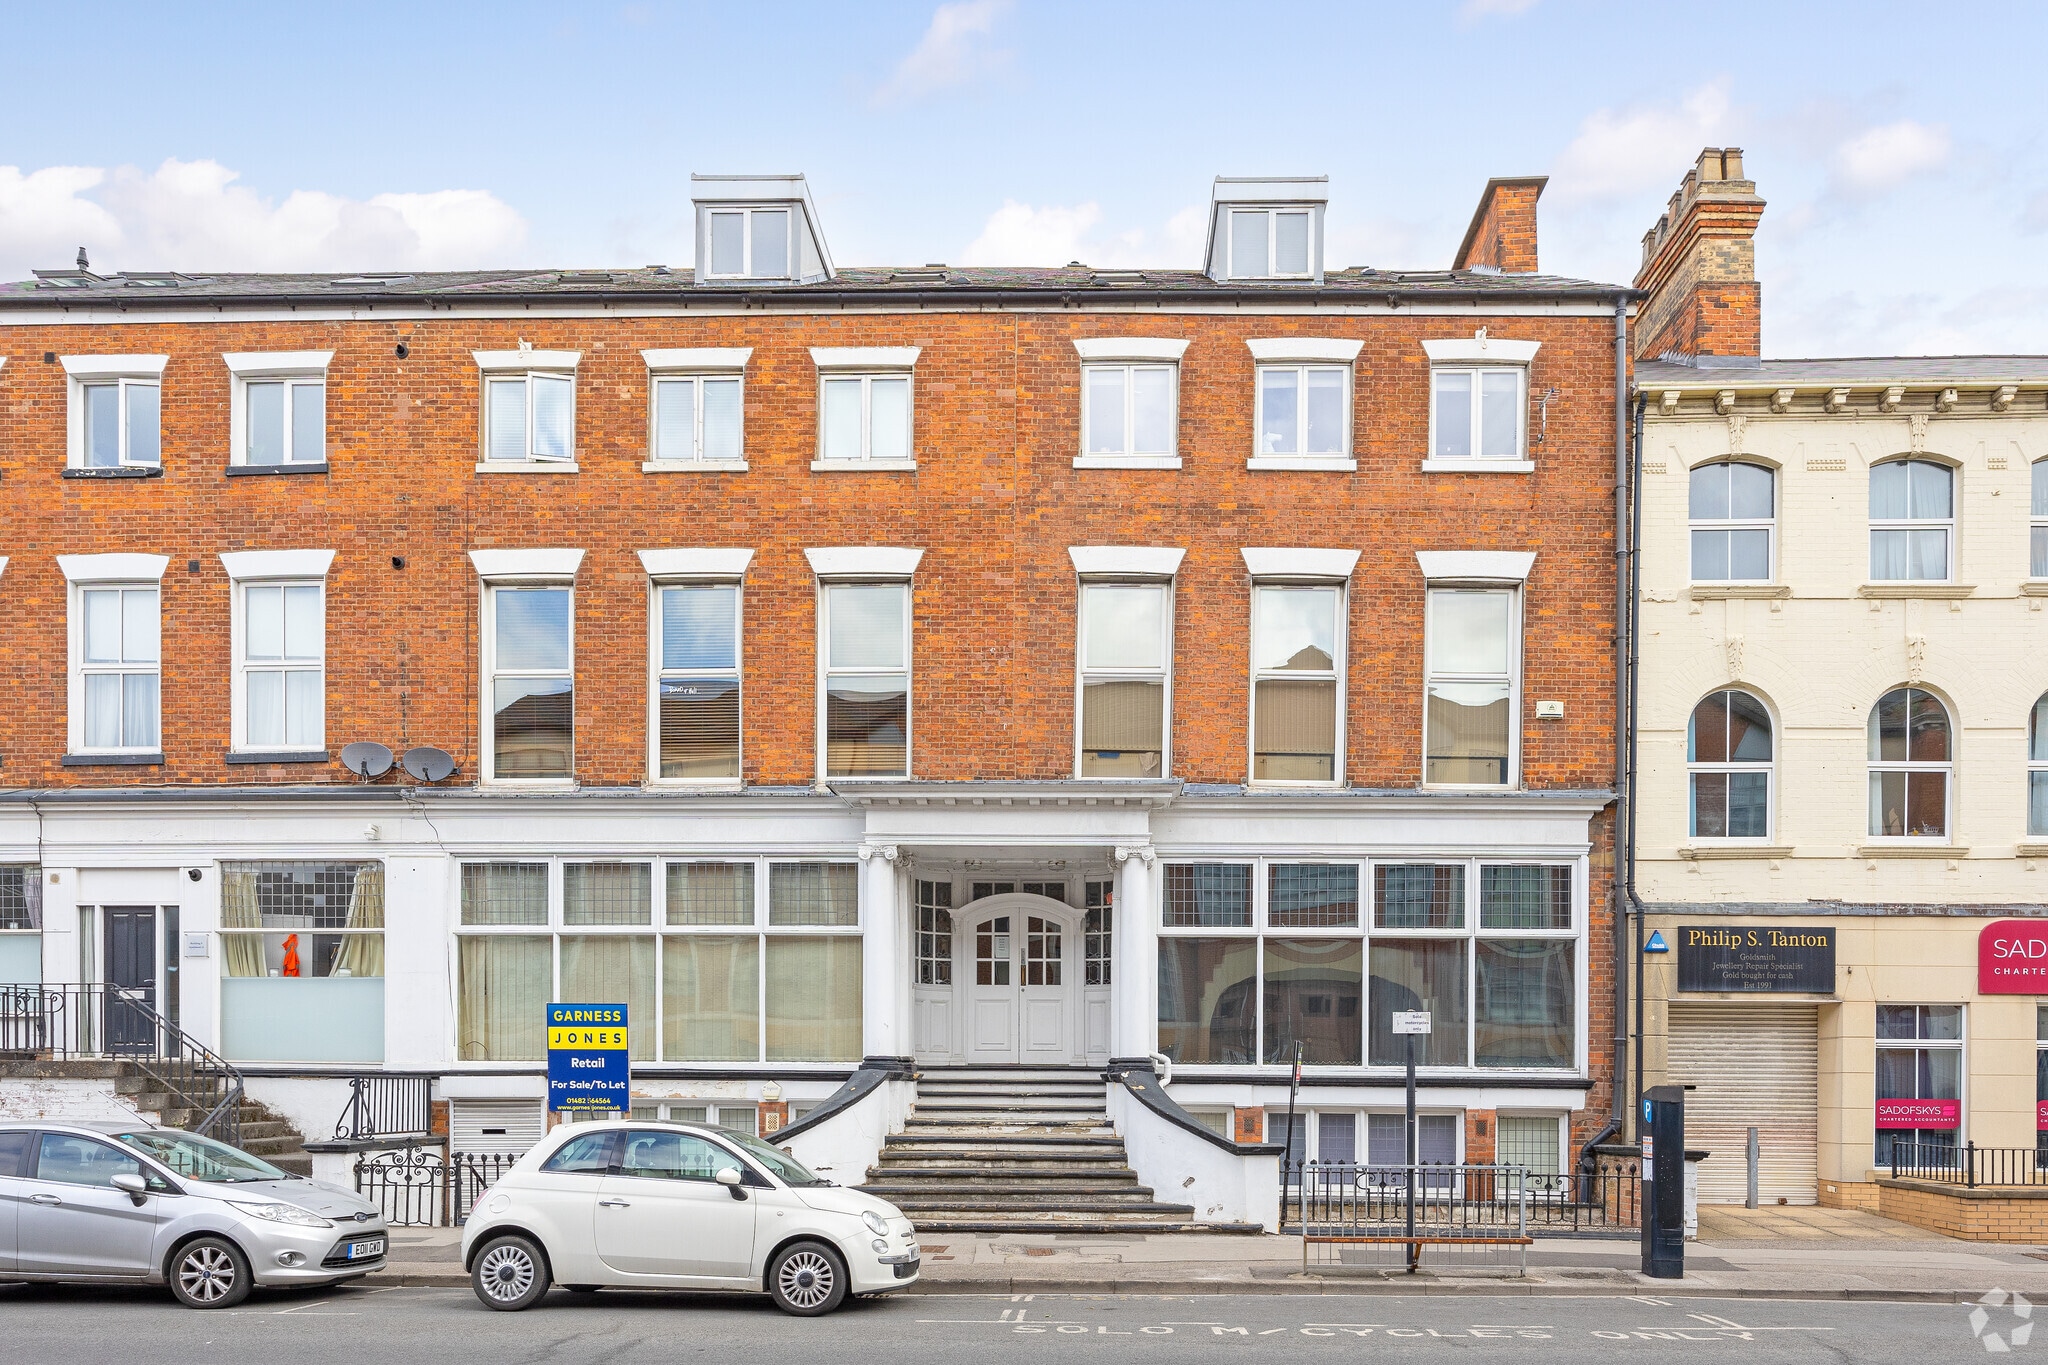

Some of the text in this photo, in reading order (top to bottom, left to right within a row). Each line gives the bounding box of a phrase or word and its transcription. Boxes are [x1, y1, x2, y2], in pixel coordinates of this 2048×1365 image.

[1688, 930, 1828, 950] Philip S. Tanton
[1993, 939, 2048, 959] SAD
[1739, 953, 1776, 961] Goldsmith
[1712, 962, 1804, 971] Jewellery Repair Specialist
[1994, 967, 2047, 975] CHARTE
[1722, 971, 1740, 979] Gold
[1741, 971, 1765, 980] bought
[1766, 971, 1777, 979] for
[1743, 981, 1772, 989] Est 1991
[553, 1010, 621, 1022] GARNESS
[554, 1032, 621, 1044] JONES
[571, 1057, 605, 1068] Retail
[551, 1080, 626, 1090] For Sale/To Let
[1645, 1101, 1651, 1119] P
[1879, 1105, 1941, 1115] SADOFSKYS
[1012, 1325, 1174, 1335] SOLO
[1590, 1330, 1754, 1341] ONLY
